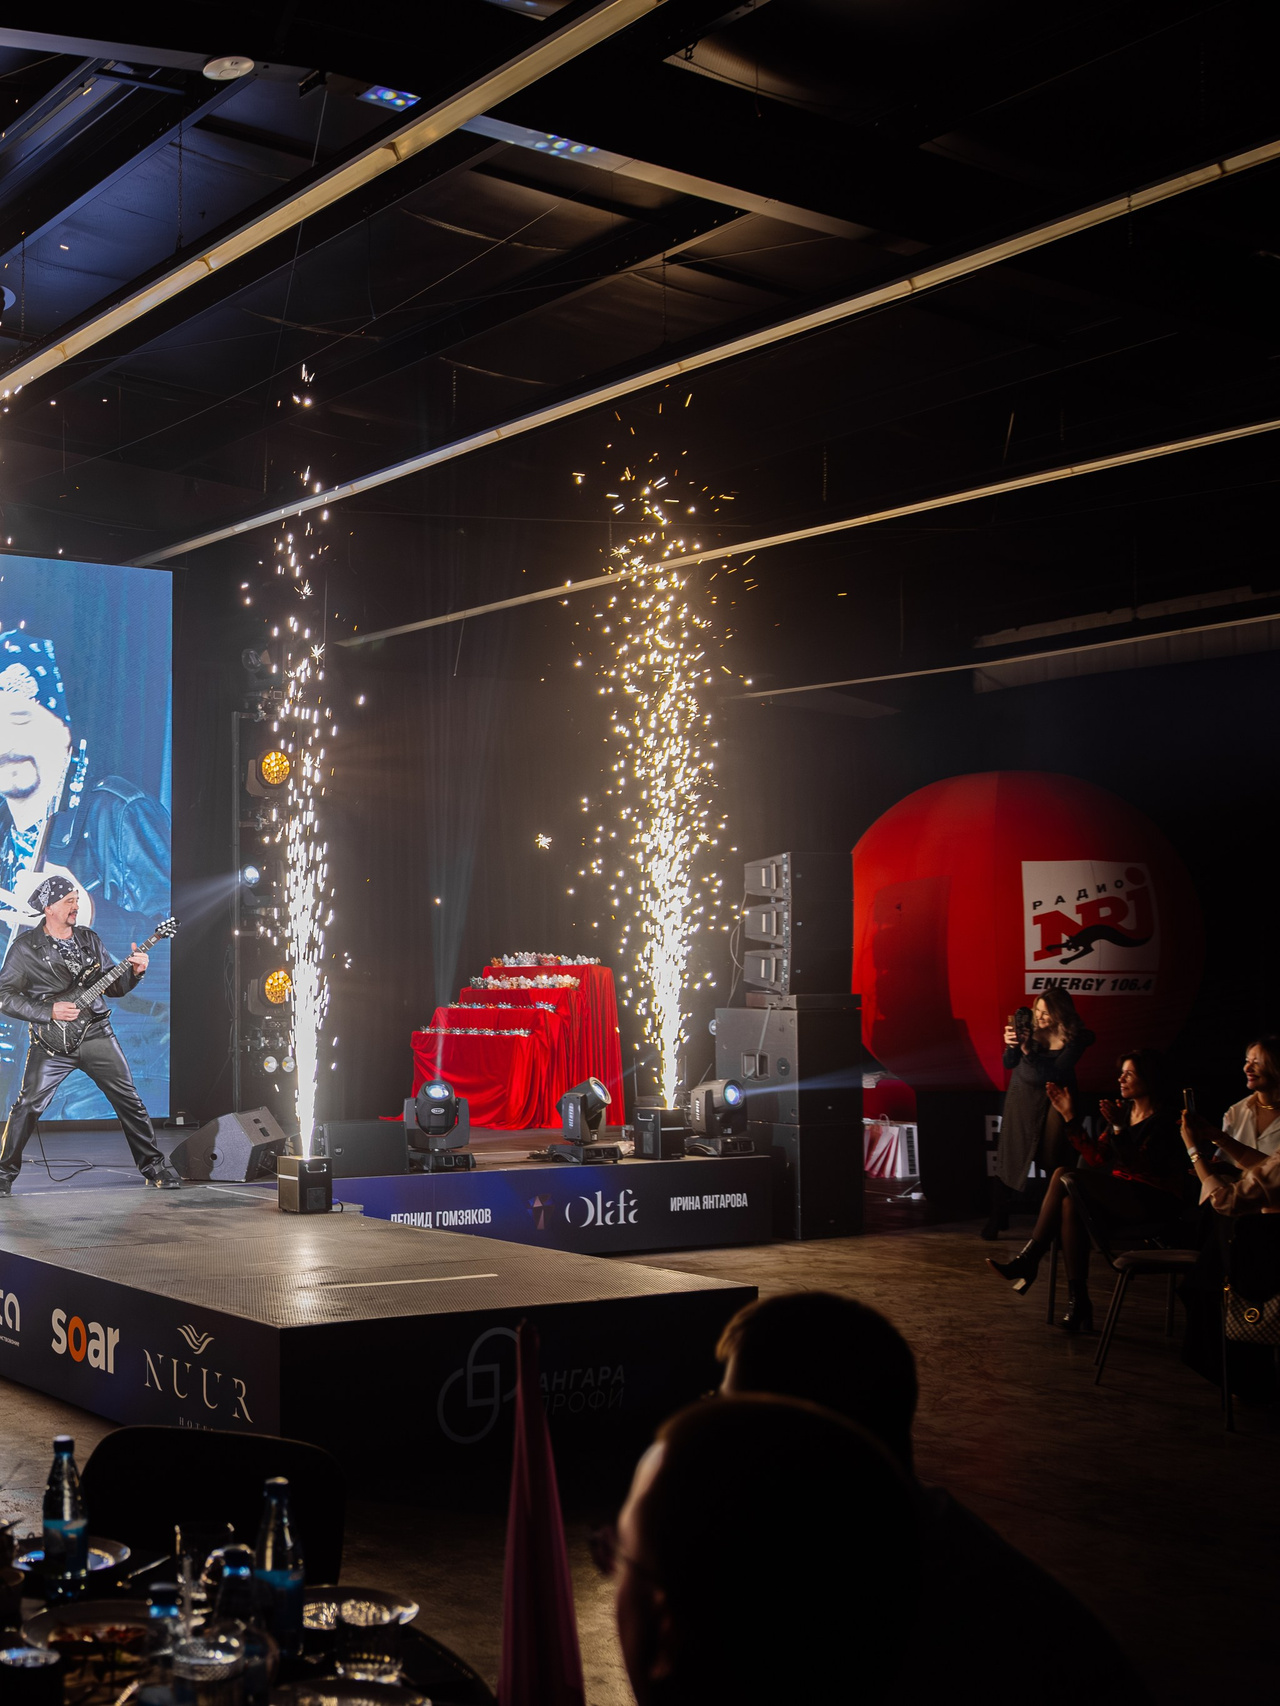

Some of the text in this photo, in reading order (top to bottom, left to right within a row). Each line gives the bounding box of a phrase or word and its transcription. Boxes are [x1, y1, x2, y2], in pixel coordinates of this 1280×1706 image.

[1032, 879, 1124, 910] РАДИО
[1032, 977, 1152, 991] ENERGY 106.4
[669, 1192, 749, 1212] ИРИНА ЯНТАРОВА
[436, 1208, 492, 1227] ГОМЗЯКОВ
[50, 1308, 120, 1374] soar
[142, 1348, 254, 1424] NUUR
[539, 1364, 625, 1392] АНГАРА
